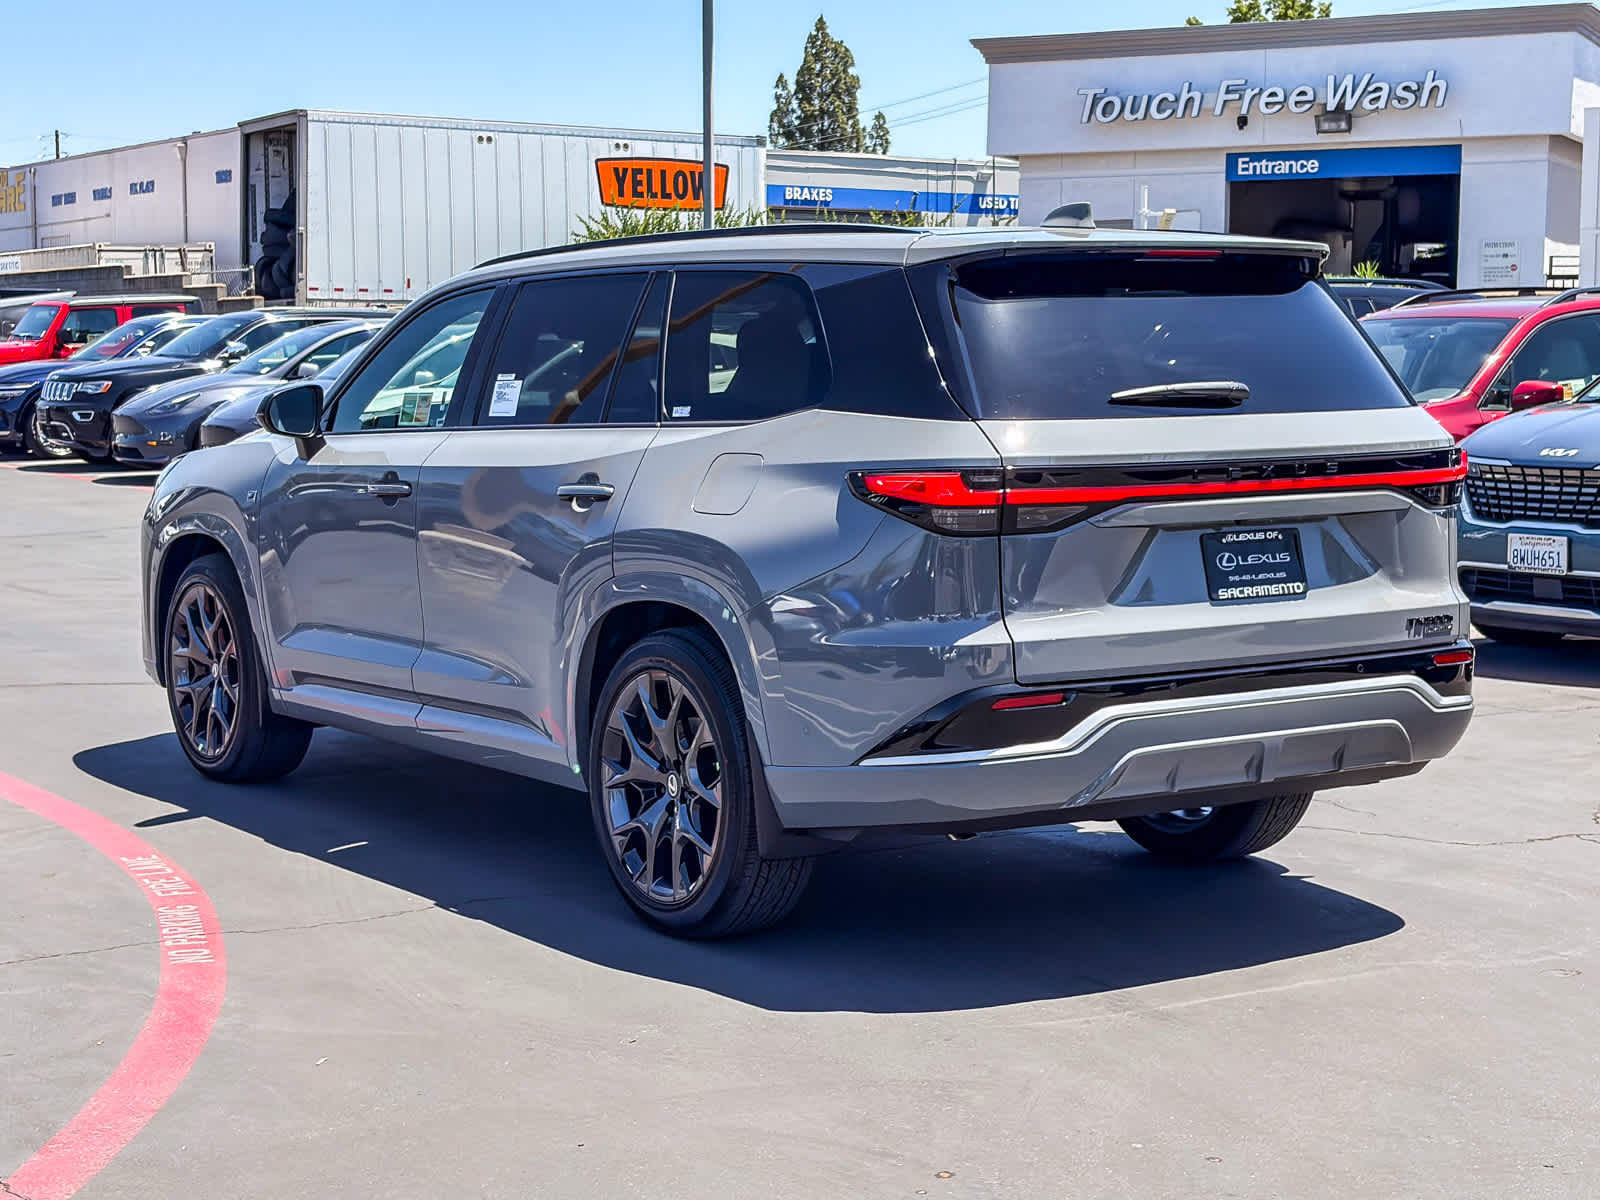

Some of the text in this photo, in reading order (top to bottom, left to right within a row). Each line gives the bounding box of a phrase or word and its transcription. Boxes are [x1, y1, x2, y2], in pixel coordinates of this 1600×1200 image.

[1077, 69, 1448, 124] Touch Free Wash
[1237, 157, 1319, 176] Entrance
[613, 167, 705, 201] YELLOW
[785, 187, 833, 201] BRAKES
[979, 196, 1008, 209] USED
[1233, 531, 1279, 541] LEXUS OF
[1238, 552, 1291, 565] LEXUS
[1512, 549, 1563, 568] 8WUH651
[1218, 582, 1304, 600] SACRAMENTO
[120, 854, 215, 964] NO PARKING FIRE LANE
